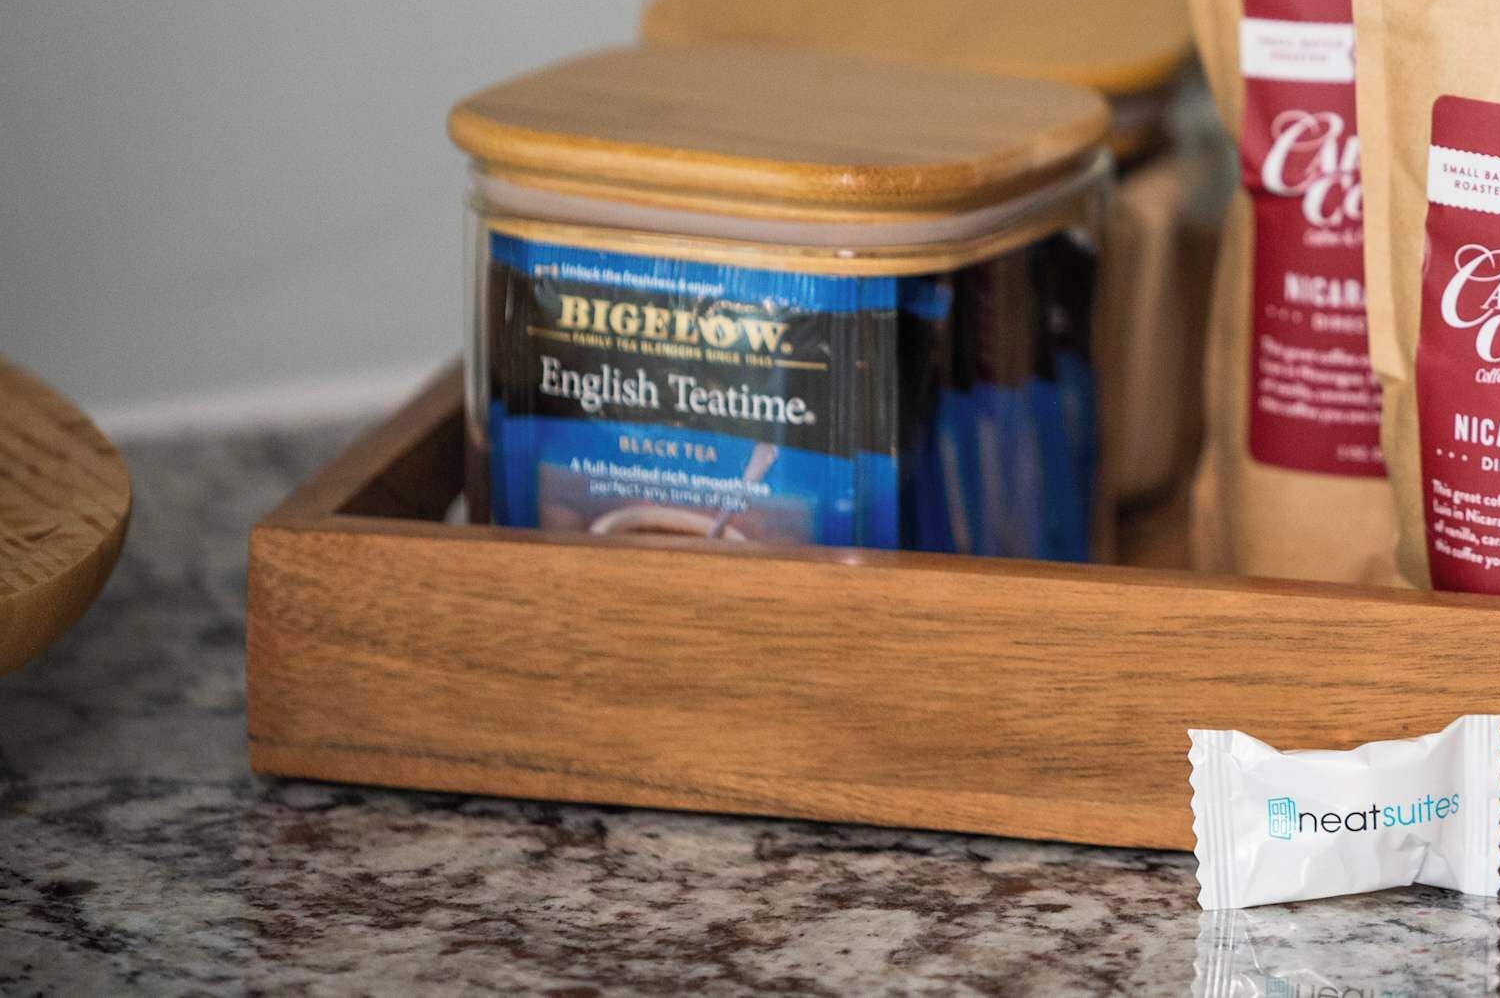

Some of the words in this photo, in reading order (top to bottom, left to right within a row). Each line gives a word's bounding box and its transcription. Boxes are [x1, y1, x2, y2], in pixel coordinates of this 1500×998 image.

[1442, 163, 1480, 179] SMALL
[539, 355, 660, 415] English
[618, 435, 679, 458] BLACK
[683, 442, 719, 464] TEA
[1452, 490, 1482, 505] great
[1452, 545, 1484, 564] coffee
[1298, 792, 1461, 834] neatsuites
